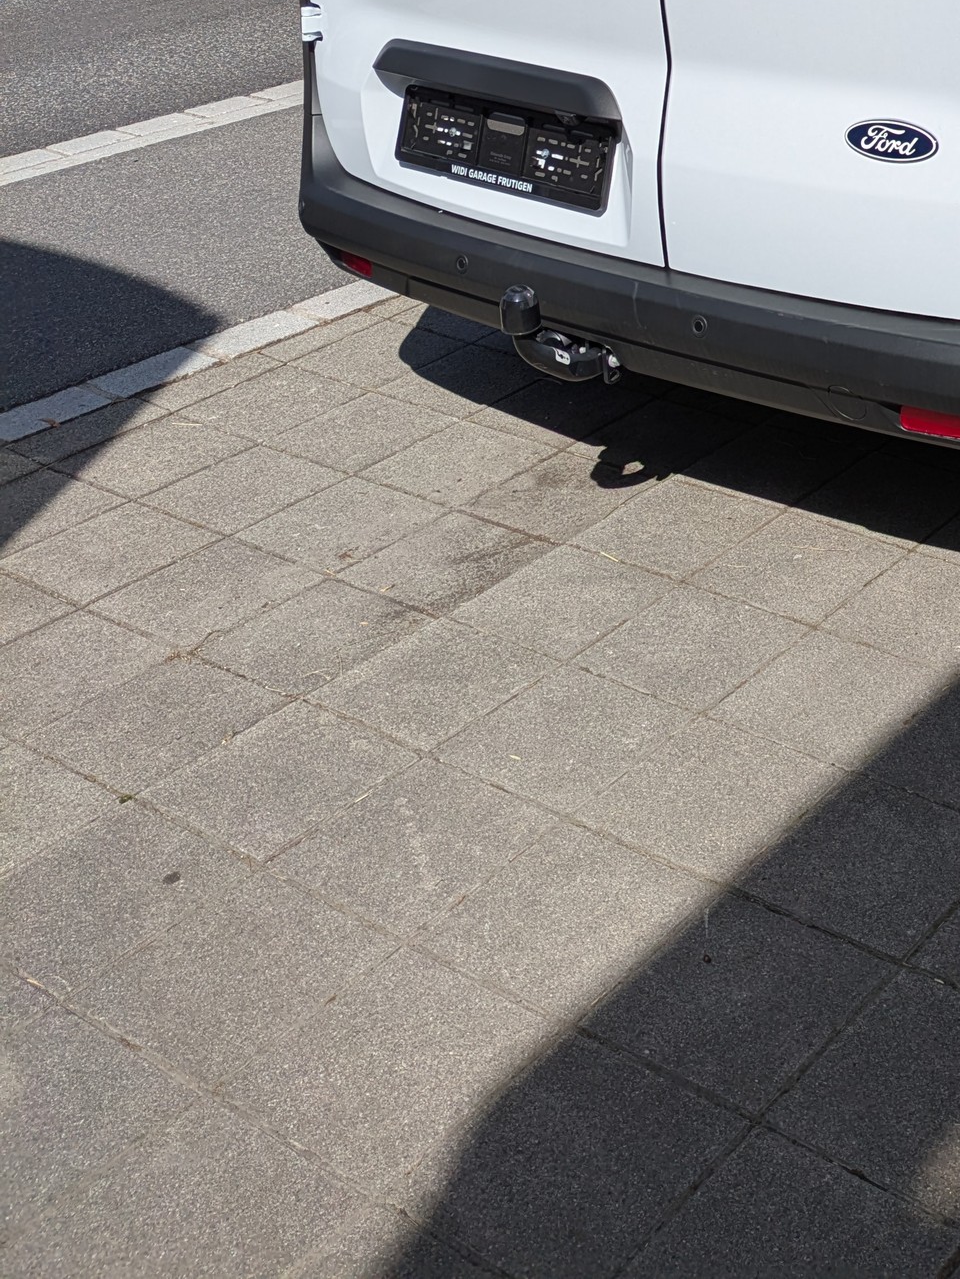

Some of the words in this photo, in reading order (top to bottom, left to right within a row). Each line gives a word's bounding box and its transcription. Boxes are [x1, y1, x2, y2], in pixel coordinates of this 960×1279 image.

[860, 125, 919, 156] Ford
[451, 164, 468, 176] WIDI
[468, 168, 497, 184] GARAGE
[497, 176, 533, 193] FRUTIGEN
